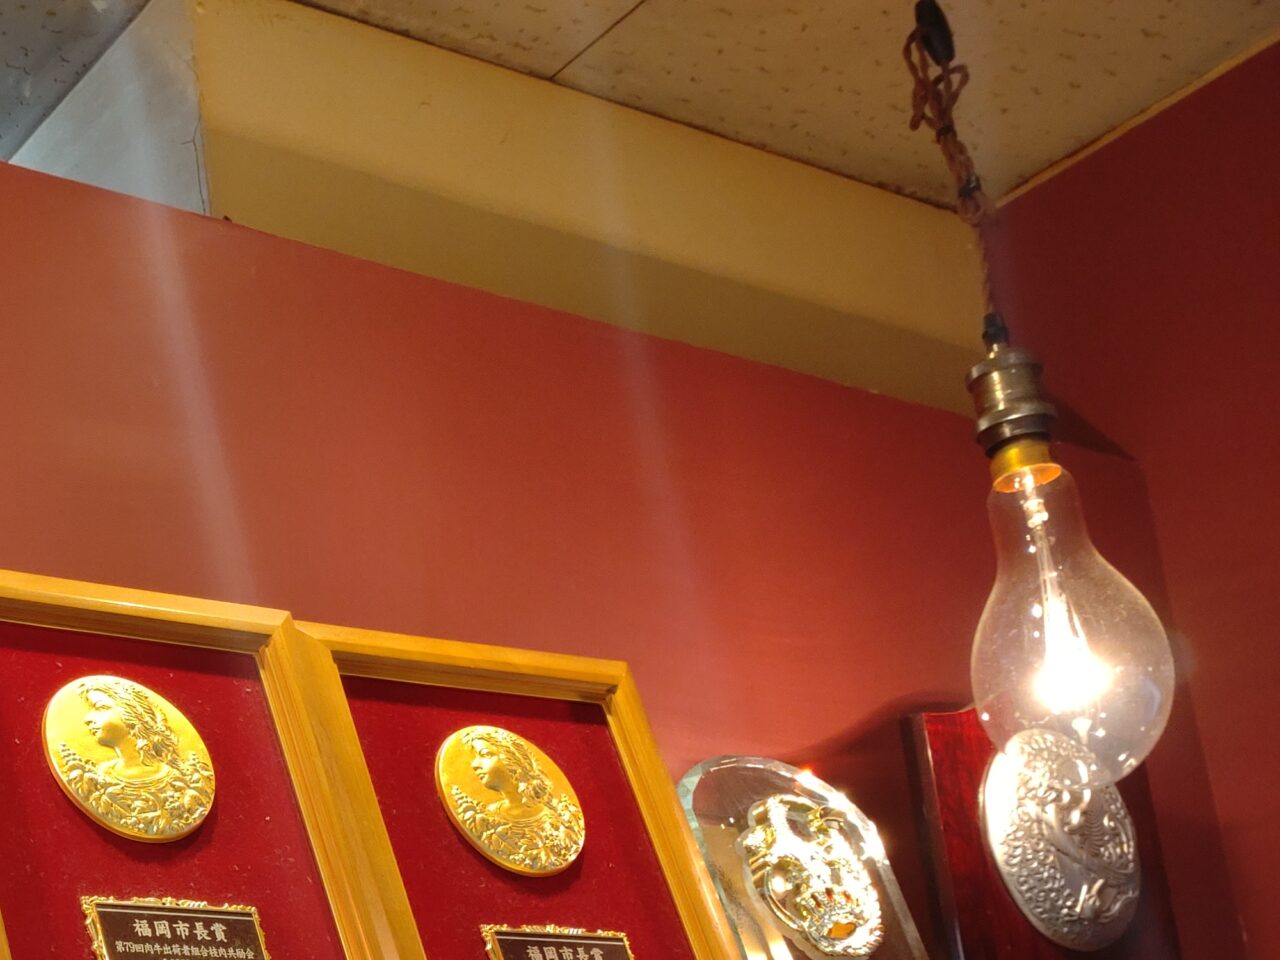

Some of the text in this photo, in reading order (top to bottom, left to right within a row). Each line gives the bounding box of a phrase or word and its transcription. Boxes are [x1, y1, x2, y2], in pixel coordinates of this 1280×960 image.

[133, 918, 228, 943] 福岡市長賞
